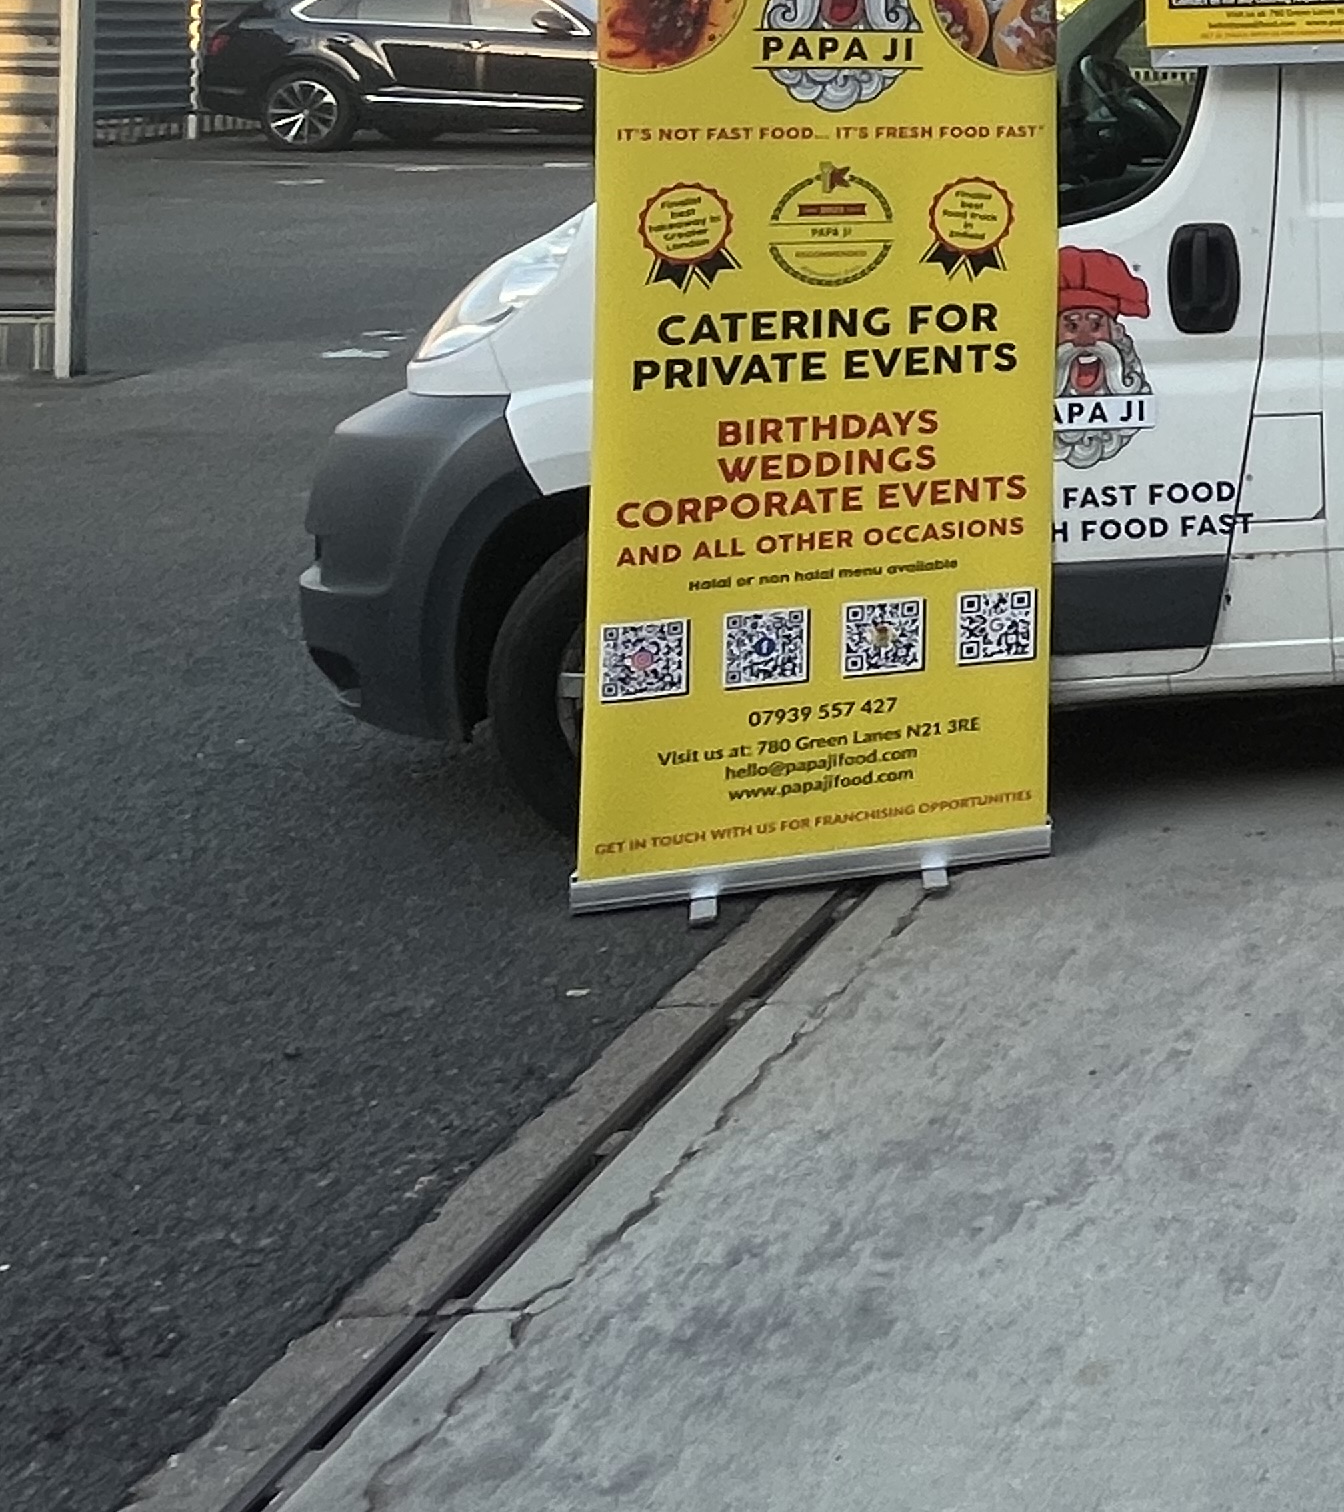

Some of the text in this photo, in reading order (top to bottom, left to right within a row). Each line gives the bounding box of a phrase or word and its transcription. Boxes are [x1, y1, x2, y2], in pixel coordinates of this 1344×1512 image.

[761, 35, 913, 62] PAPA JI
[617, 128, 652, 141] IT'S
[659, 128, 699, 141] NOT
[707, 127, 753, 140] FAST
[836, 127, 868, 139] IT'S
[876, 126, 932, 138] FRESH
[940, 126, 990, 138] FOOD
[657, 302, 997, 345] CATERING FOR
[632, 342, 1017, 391] PRIVATE EVENTS
[718, 409, 938, 446] BIRTHDAYS
[1119, 400, 1145, 422] JI
[718, 445, 936, 483] WEDDINGS
[616, 474, 1027, 528] CORPORATE EVENTS
[1063, 481, 1235, 509] FAST FOOD
[616, 544, 681, 567] AND
[693, 539, 745, 560] ALL
[756, 530, 852, 554] OTHER
[864, 517, 1024, 546] OCCASIONS
[1083, 517, 1168, 540] FOOD
[1181, 513, 1253, 537] FAST
[689, 558, 957, 591] Halal or non halal menu available
[748, 697, 897, 727] 07939 557 427
[658, 748, 698, 766] Visit
[704, 747, 723, 760] us
[757, 738, 790, 755] 780
[796, 733, 847, 751] Green
[853, 729, 900, 746] Lanes
[907, 722, 941, 738] N21
[947, 717, 980, 733] 3RE
[724, 746, 917, 780] hello@papajifood.com
[729, 767, 913, 801] www.papajifood.com
[595, 789, 1032, 855] GET IN TOUCH WITH US FOR FRANCHISING OPPORTUNITIES
